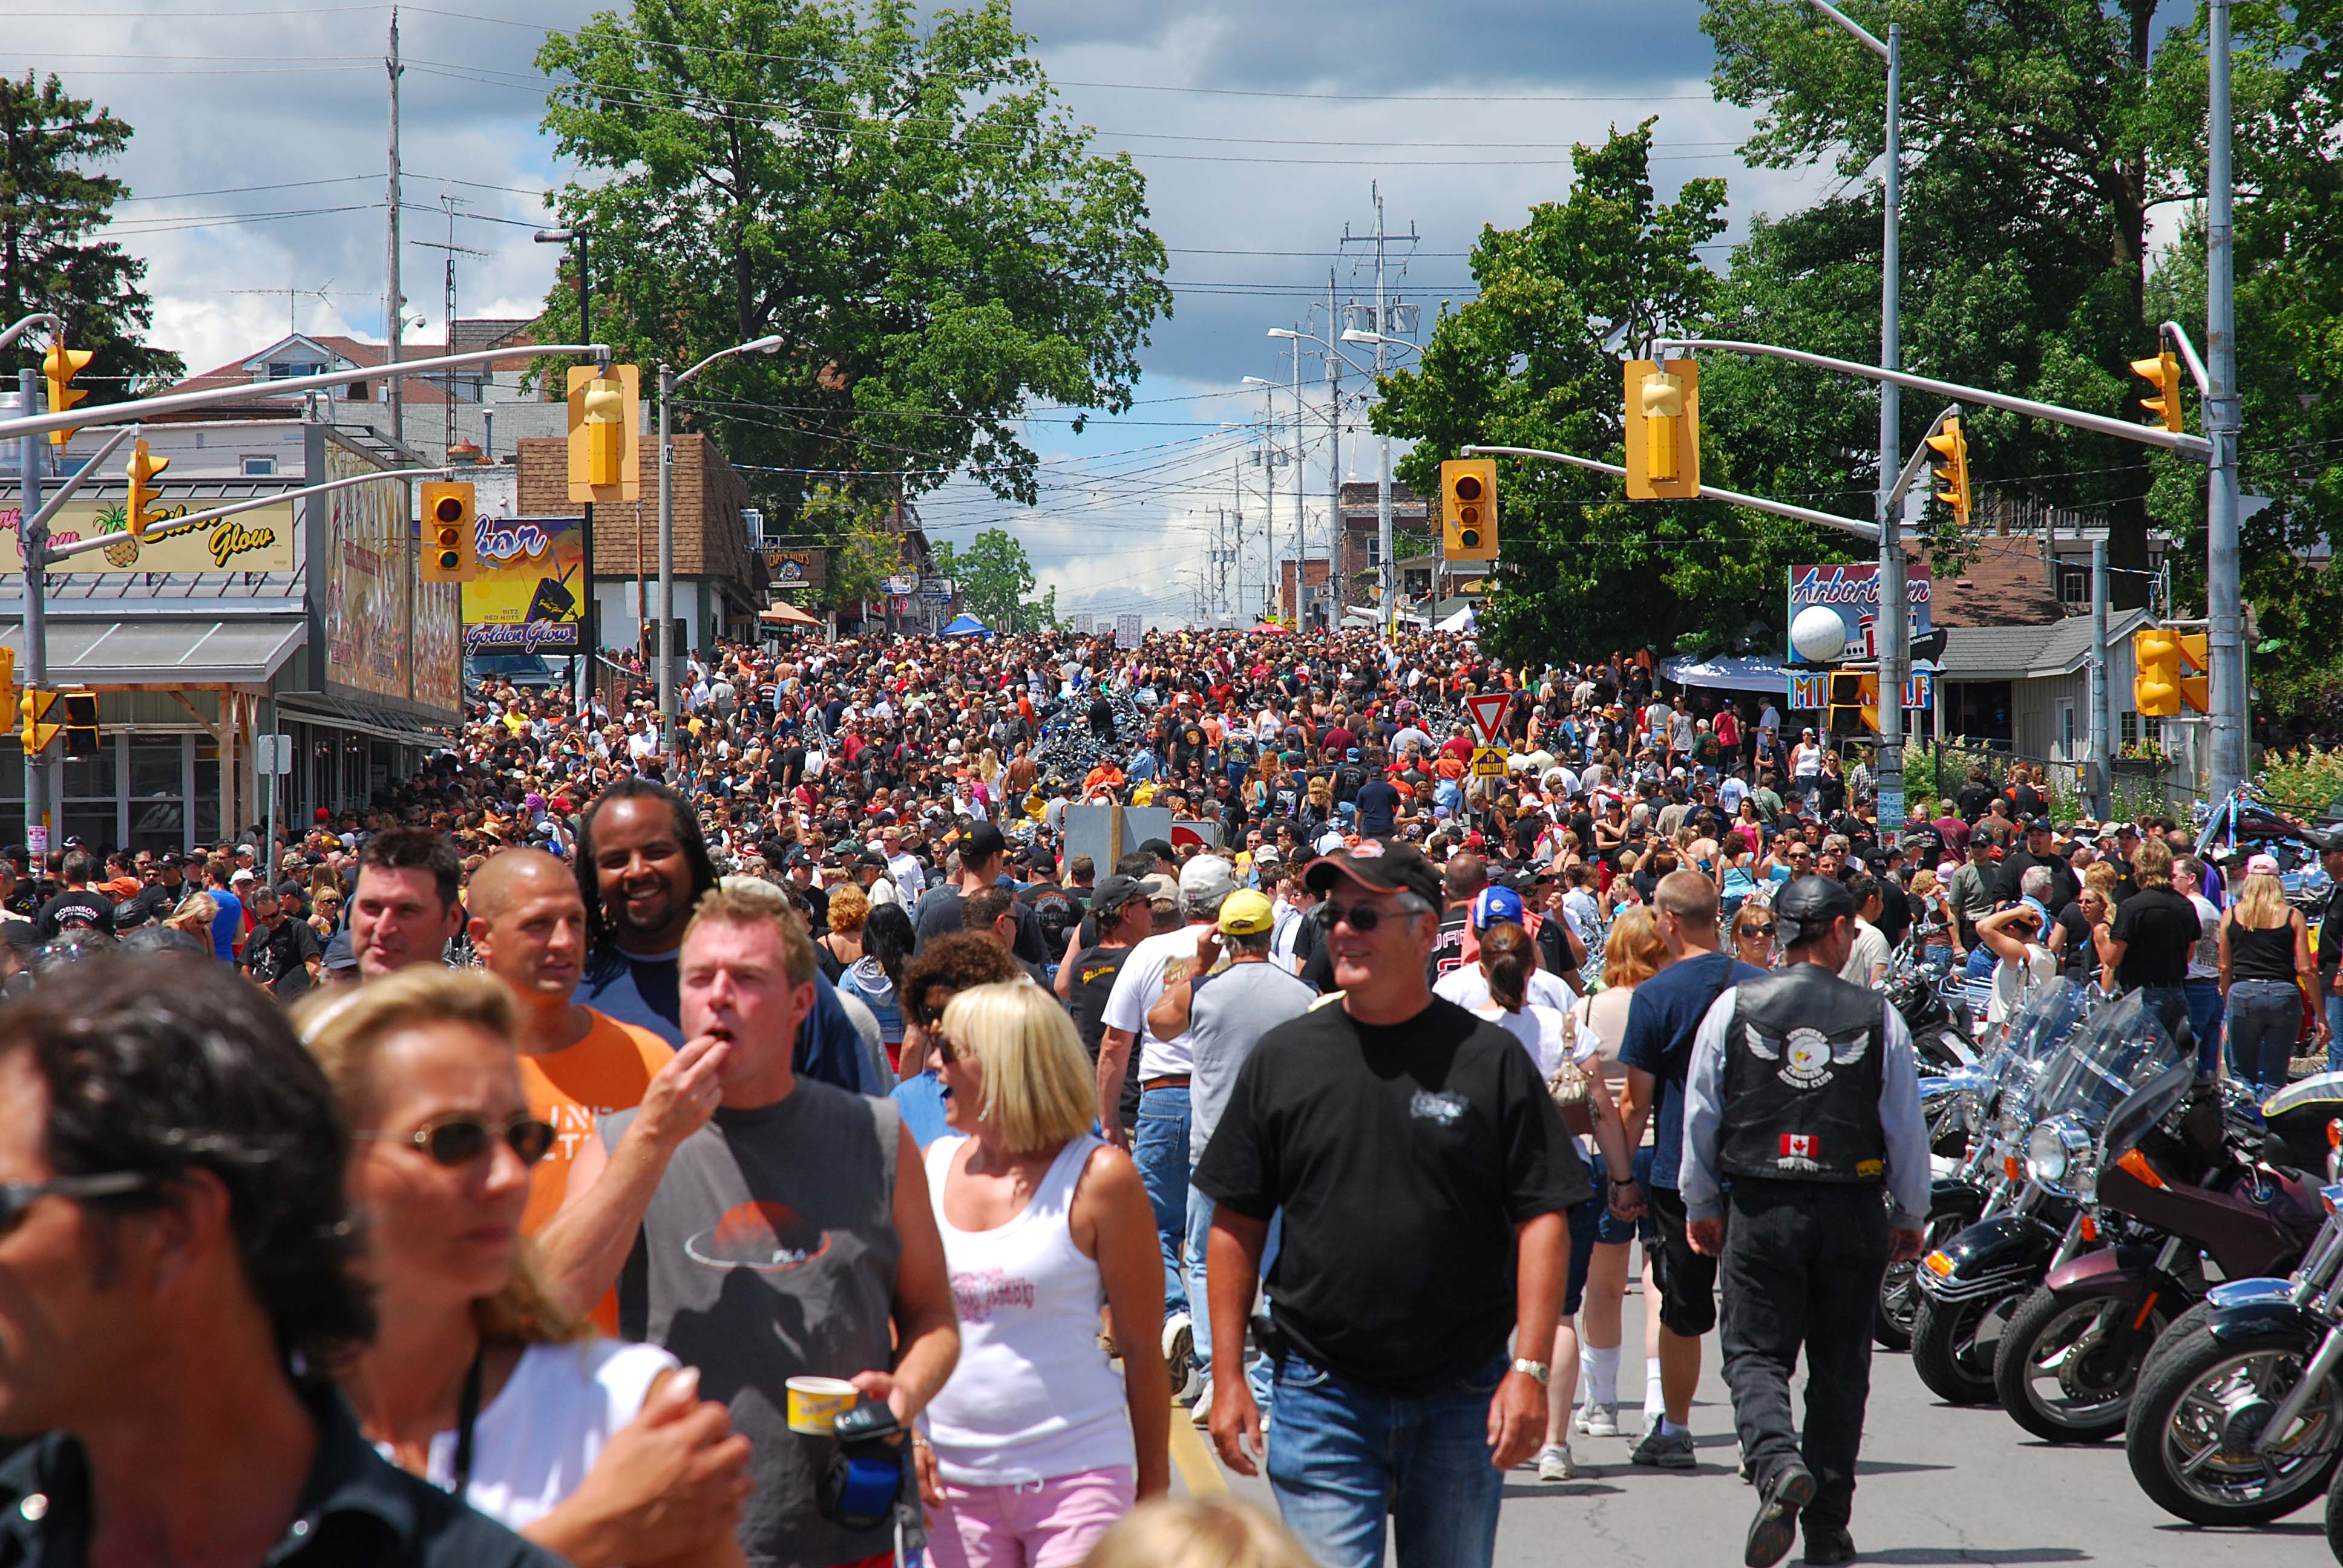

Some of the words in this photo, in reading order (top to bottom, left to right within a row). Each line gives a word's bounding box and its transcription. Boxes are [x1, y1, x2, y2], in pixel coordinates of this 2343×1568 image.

[209, 522, 275, 568] Glow
[1792, 567, 1932, 604] Arbortn
[466, 622, 523, 656] Golden
[525, 619, 570, 653] Glow
[1486, 754, 1495, 762] TO
[1480, 763, 1501, 773] CONCERT
[54, 906, 99, 920] ROBINSON
[1810, 1071, 1834, 1088] CLUB
